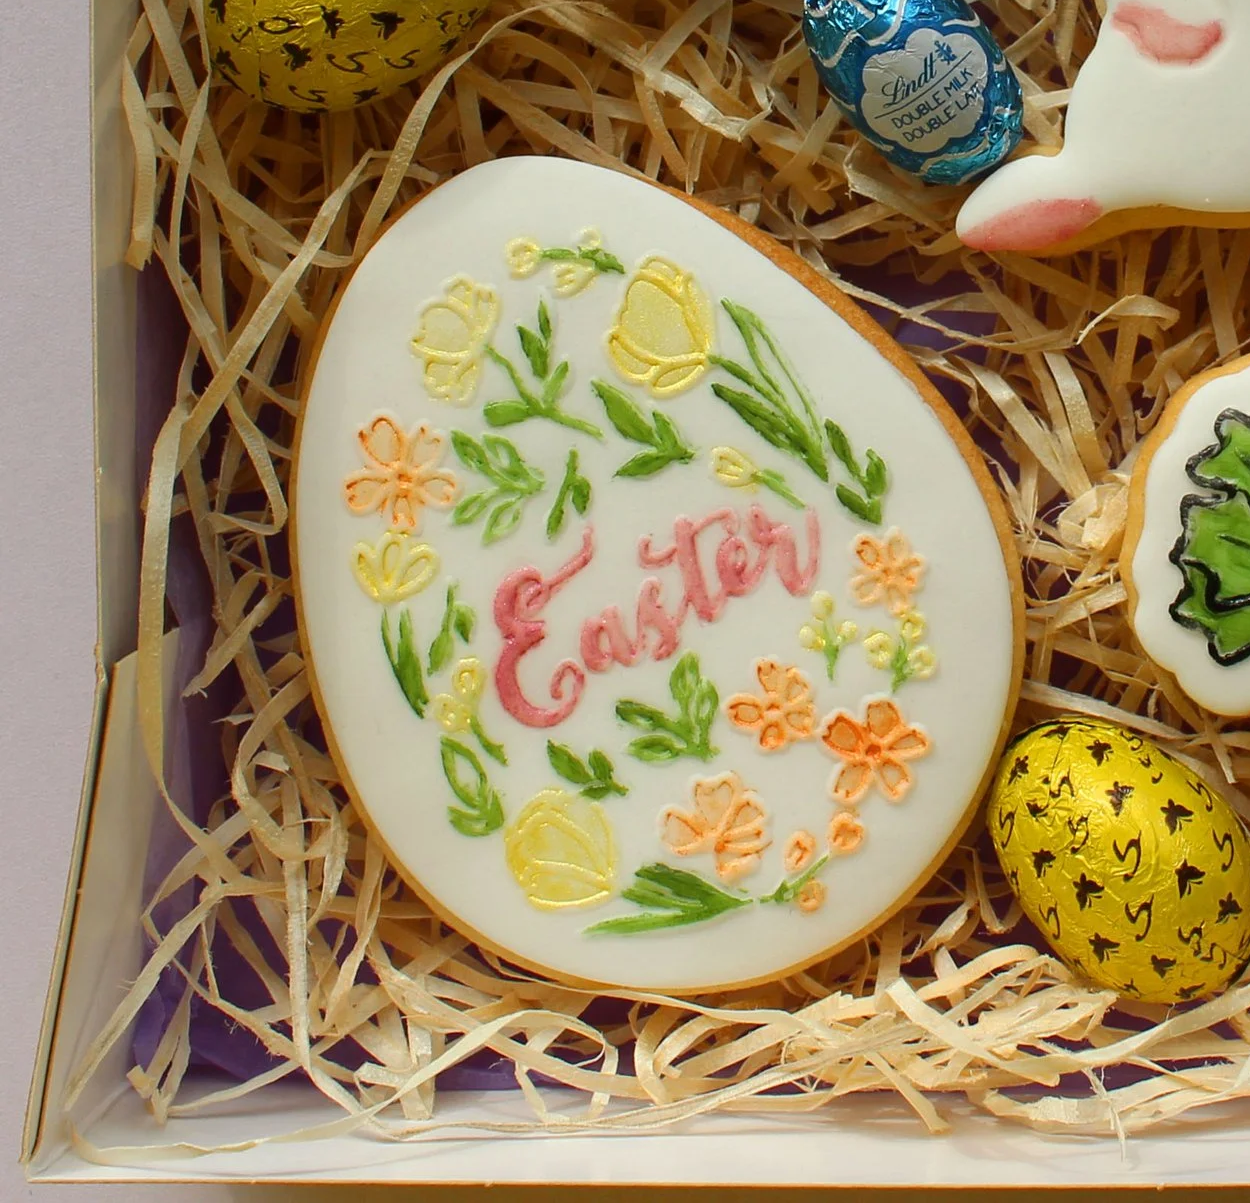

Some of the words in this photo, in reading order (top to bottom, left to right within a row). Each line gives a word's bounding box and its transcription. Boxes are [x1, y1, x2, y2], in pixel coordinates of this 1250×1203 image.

[881, 52, 938, 109] Lindt
[891, 91, 946, 129] DOUBLE
[943, 68, 973, 97] MILK
[902, 106, 957, 142] DOUBLE
[492, 504, 822, 729] Easter
